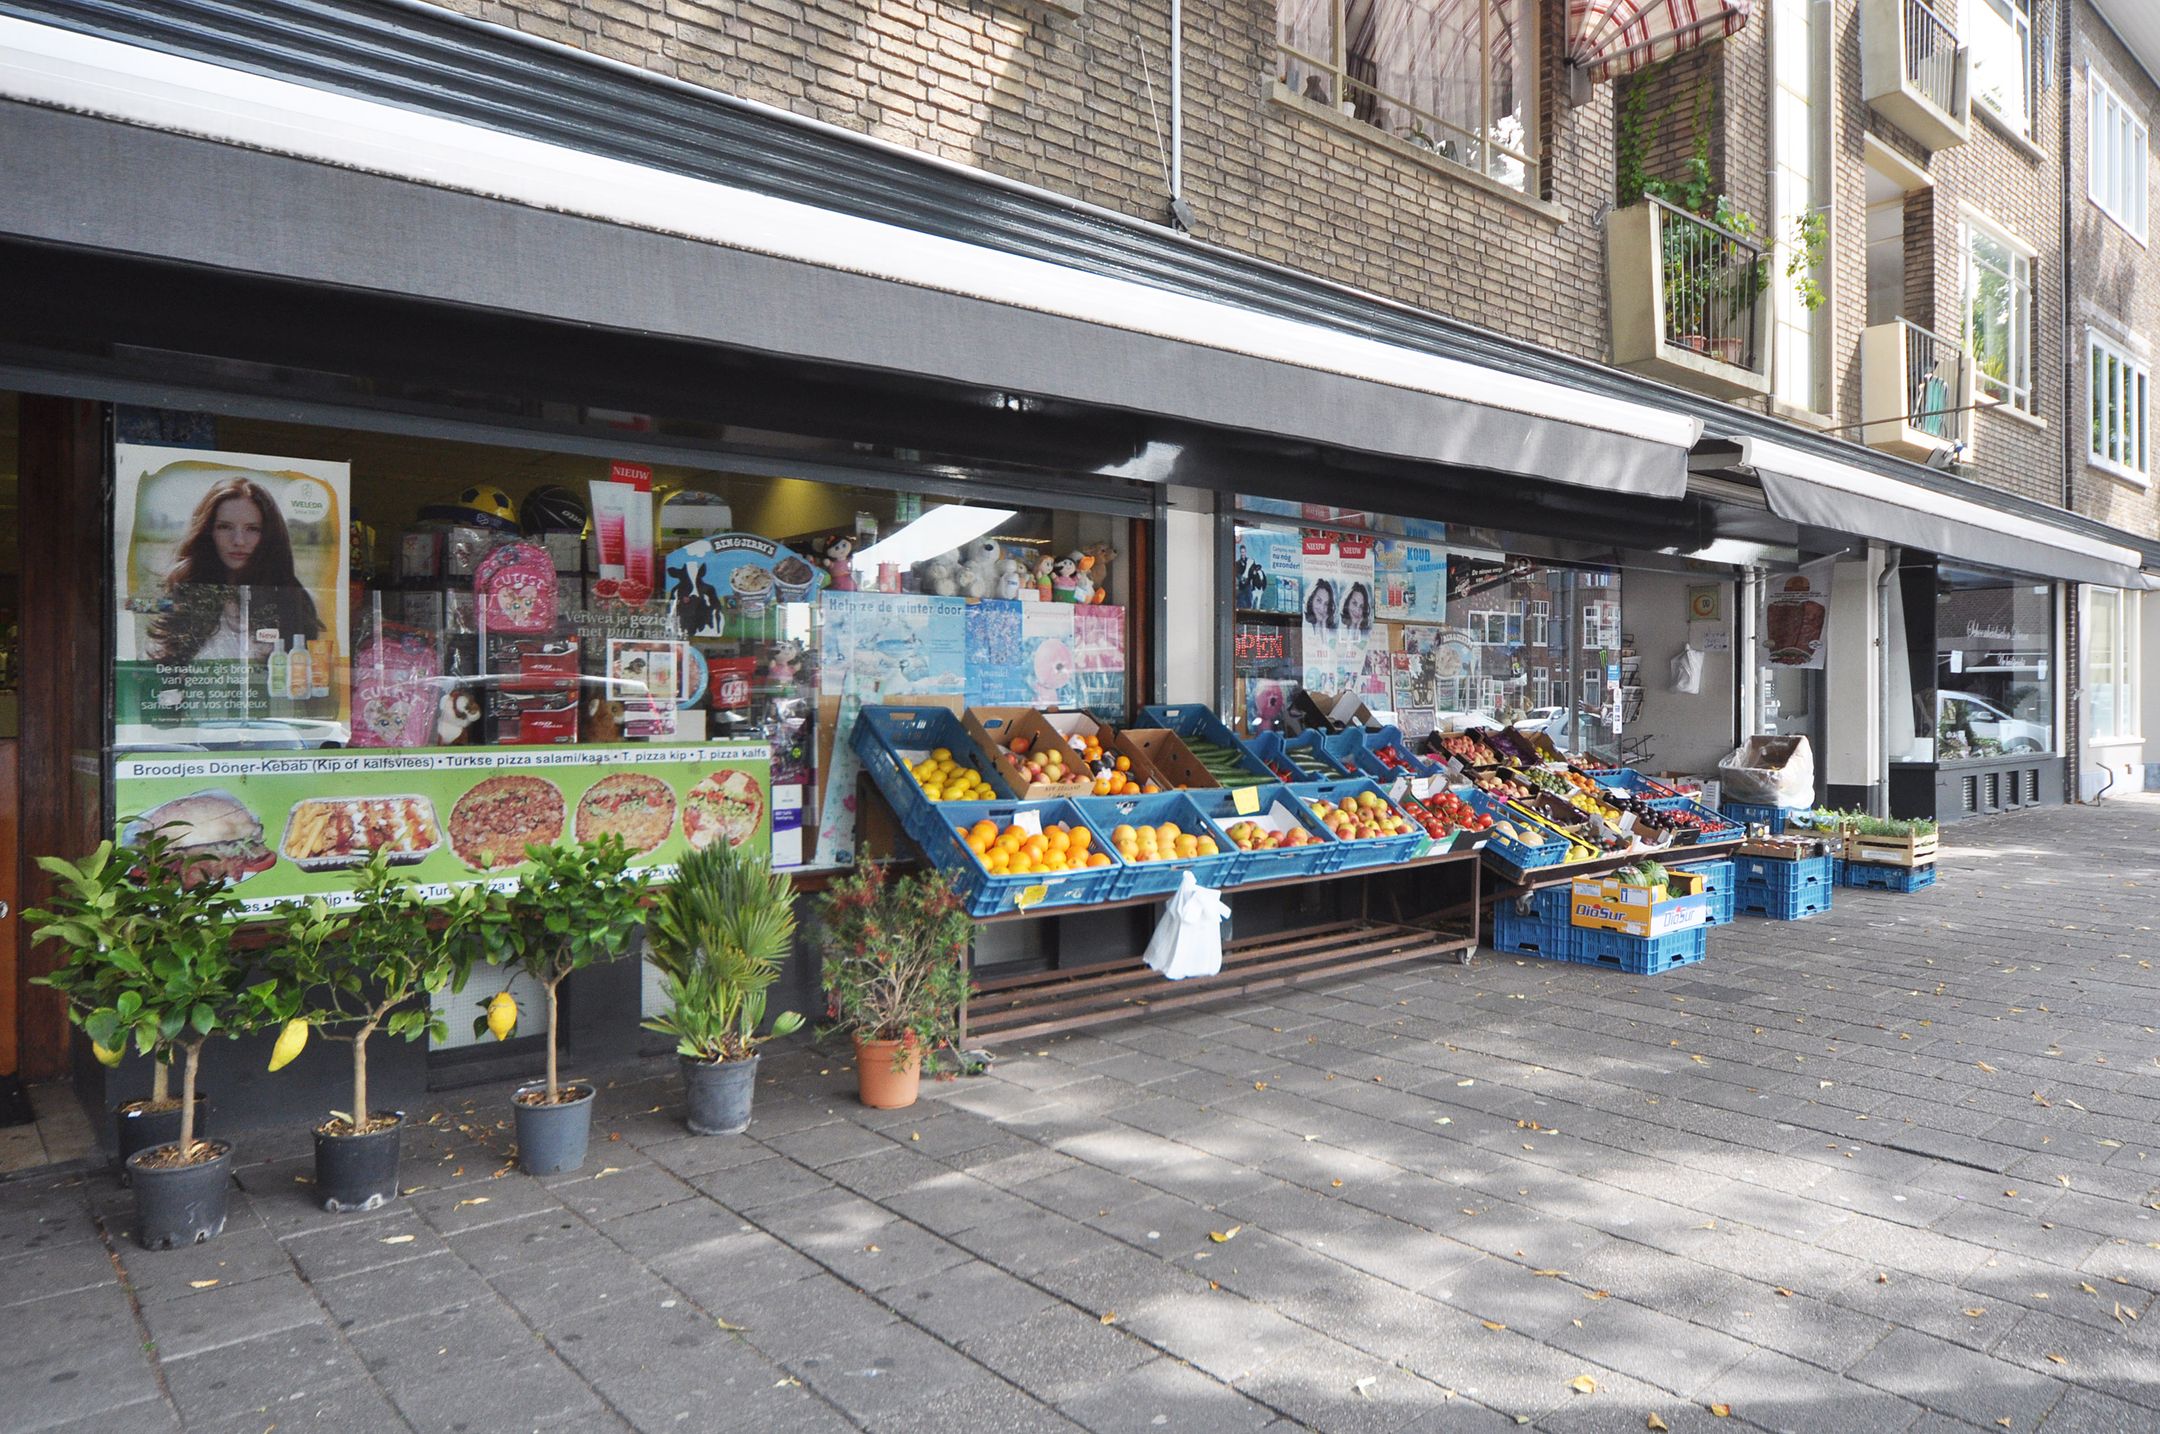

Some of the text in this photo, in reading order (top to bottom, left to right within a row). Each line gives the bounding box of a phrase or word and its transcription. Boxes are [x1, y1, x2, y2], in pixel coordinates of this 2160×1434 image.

[612, 466, 650, 480] NIEUW
[1305, 543, 1326, 551] NIEUW
[1342, 547, 1363, 555] NIEUW
[1406, 546, 1431, 562] KOUD
[829, 598, 962, 615] Help ze de winter door
[565, 611, 613, 623] Verwen
[615, 613, 628, 627] je
[577, 627, 602, 637] met
[607, 627, 642, 638] puur
[156, 663, 254, 674] De natuur als bron
[161, 676, 182, 685] van
[185, 675, 224, 687] gezond
[208, 690, 241, 699] source
[243, 689, 258, 698] de
[175, 701, 199, 711] pour
[202, 701, 221, 709] vos
[224, 699, 268, 709] cheveux
[133, 763, 204, 777] Broodjes
[209, 760, 308, 774] Döner-Kebab
[312, 759, 341, 773] (Kip
[345, 758, 359, 770] of
[363, 757, 435, 770] kalfsvlees)
[497, 754, 531, 767] pizza
[536, 752, 610, 764] salami/kaas
[622, 751, 632, 761] T.
[636, 750, 666, 762] pizza
[670, 749, 687, 761] kip
[698, 749, 708, 759] T.
[710, 749, 738, 760] pizza
[742, 747, 766, 758] kalfs
